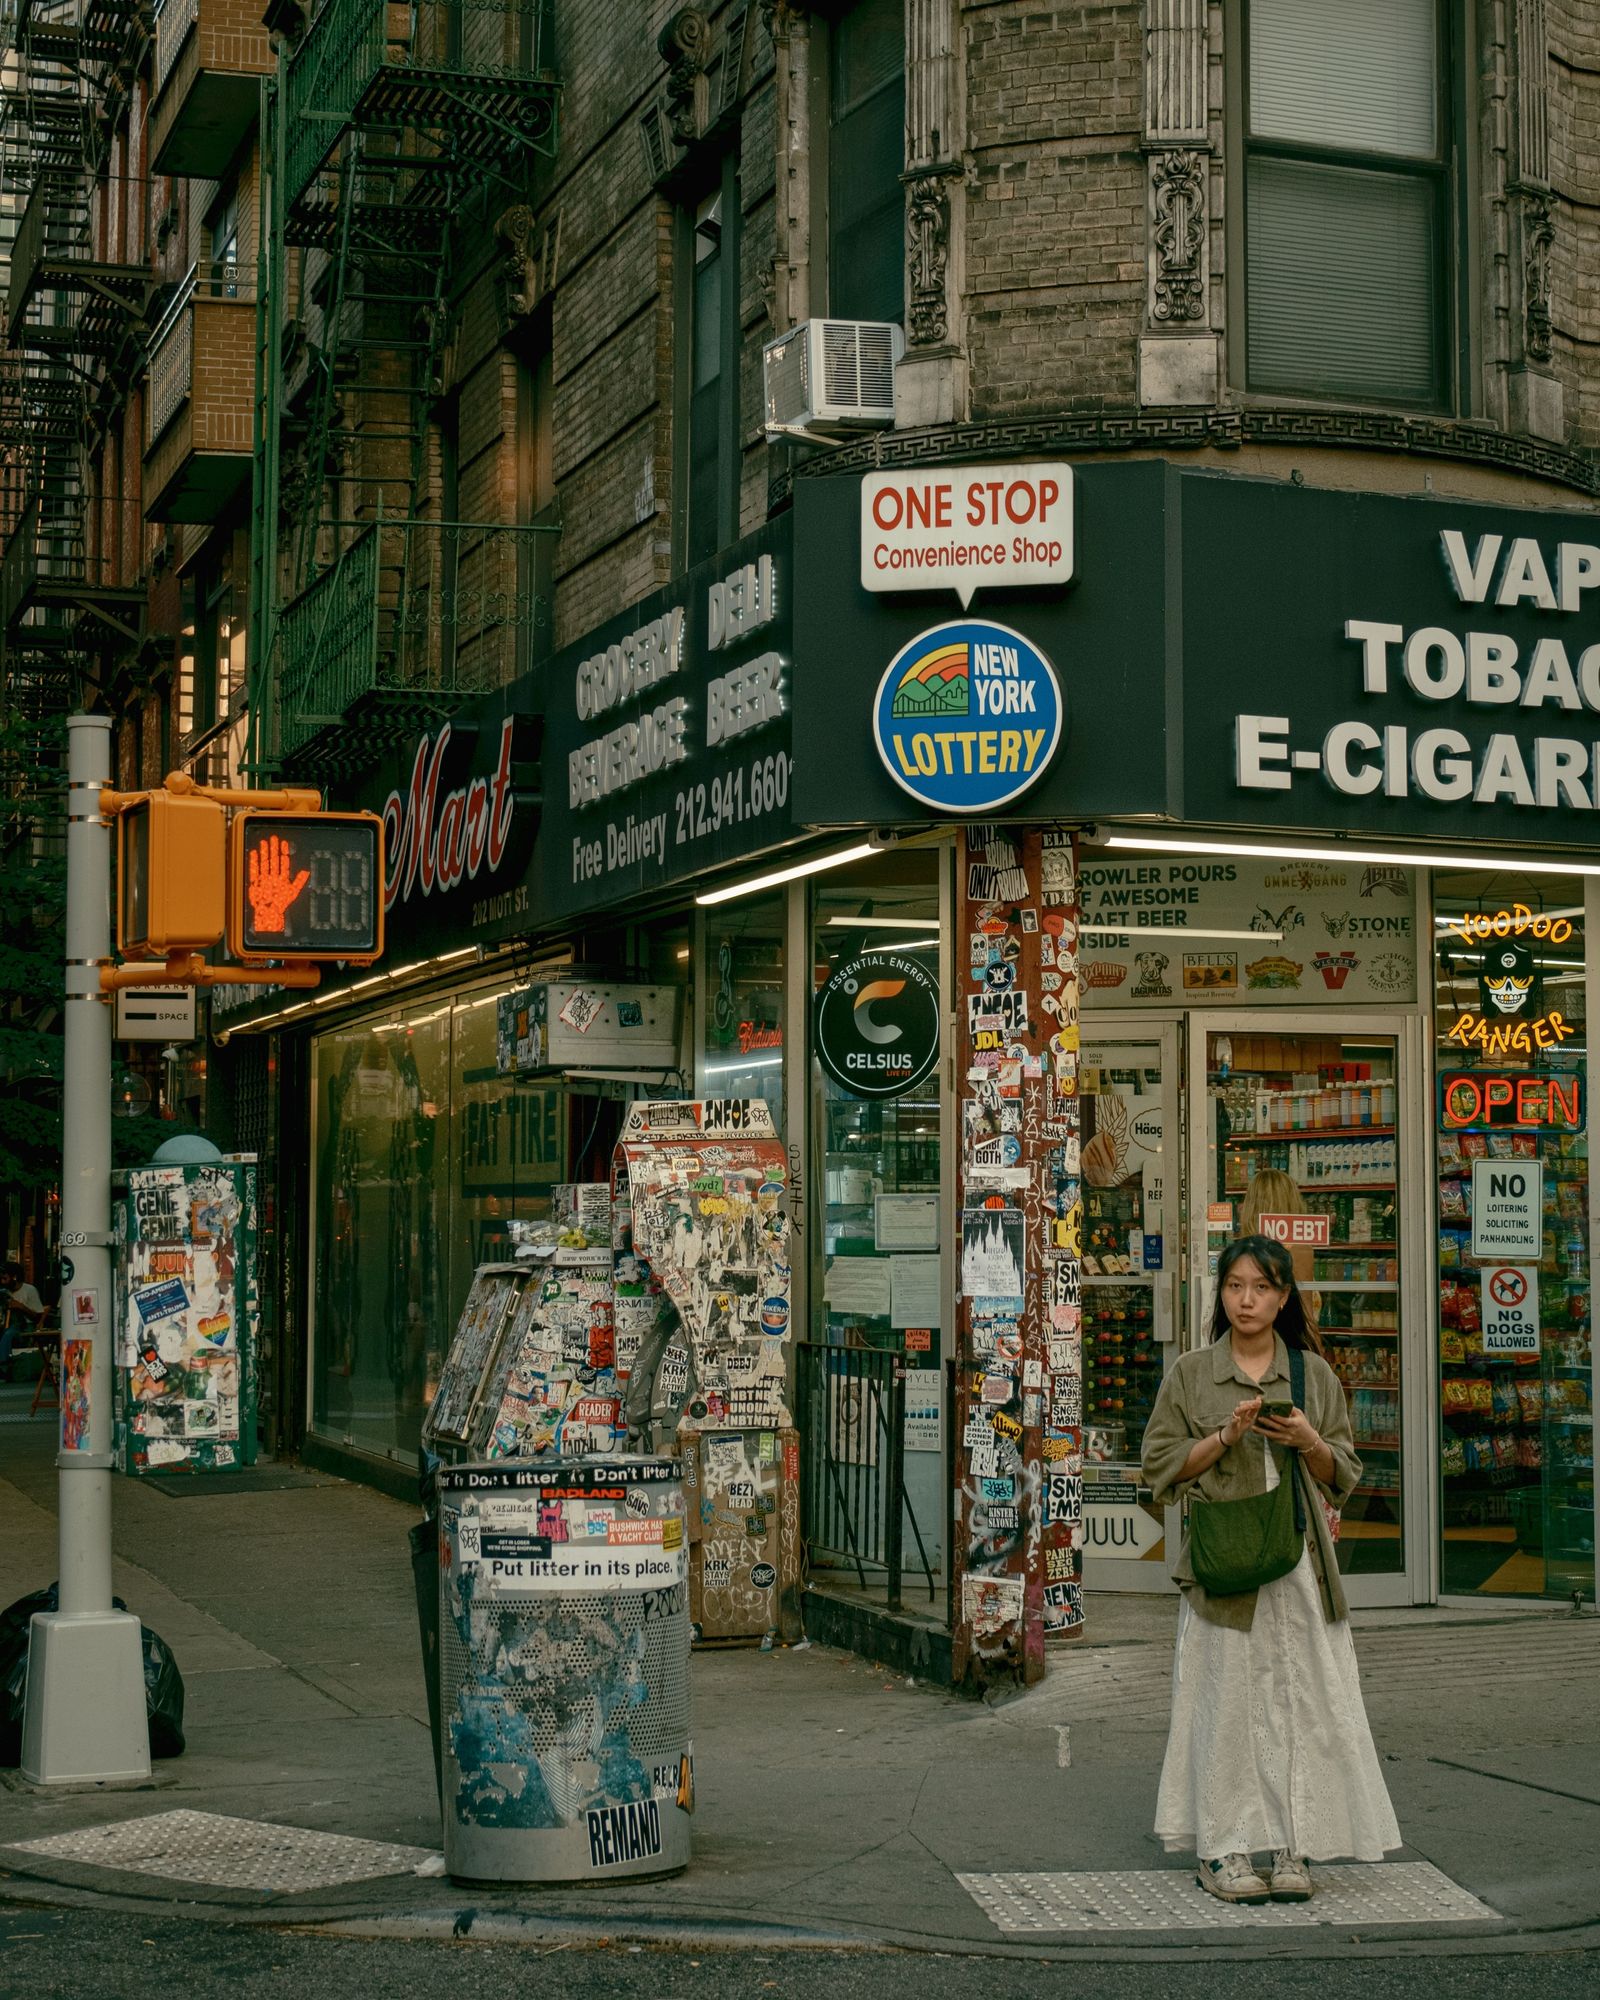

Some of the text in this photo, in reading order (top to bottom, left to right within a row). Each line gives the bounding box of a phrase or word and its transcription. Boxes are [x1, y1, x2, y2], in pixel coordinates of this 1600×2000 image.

[873, 480, 1059, 531] ONE STOP
[874, 537, 1062, 570] Convenience Shop
[576, 554, 773, 721] GROCERY DELI
[974, 643, 1018, 677] NEW
[974, 677, 1036, 715] YORK
[569, 652, 782, 809] BEVERAGE BEER
[892, 728, 1045, 777] LOTTERY
[1235, 714, 1600, 809] E-CIGAR
[573, 751, 793, 883] Free Delivery 212.941.660
[1043, 833, 1071, 846] ELK
[1280, 862, 1330, 873] BREWERY
[1080, 865, 1237, 886] ROWLER POURS
[1081, 887, 1199, 907] F AWESOME
[472, 885, 529, 927] 202 MOTT ST.
[1080, 910, 1187, 927] RAFT BEER
[1349, 917, 1410, 931] STONE
[1450, 903, 1573, 945] VOODOO
[1079, 933, 1129, 949] NSIDE
[1187, 955, 1234, 966] BELL'S
[1315, 958, 1356, 968] VICTORY
[1370, 953, 1412, 967] ANCHOR
[829, 955, 886, 991] ESSENTIAL
[1131, 986, 1172, 995] LAGUNITAS
[1449, 1011, 1575, 1055] RANGER
[846, 1053, 912, 1069] CELSIUS
[1445, 1078, 1579, 1125] OPEN
[975, 1151, 1001, 1164] GOTH
[694, 1179, 719, 1191] wyd?
[1490, 1174, 1526, 1198] NO
[1487, 1204, 1528, 1214] LOITERING
[1264, 1219, 1326, 1241] NO EBT
[1486, 1219, 1529, 1229] SOLICITING
[1480, 1234, 1534, 1245] PANHANDLING
[136, 1280, 180, 1301] PRO-AMERICA
[146, 1302, 186, 1322] ANTI-TRUMP
[1498, 1311, 1523, 1322] NO
[906, 1330, 929, 1340] FRIENDS
[1487, 1324, 1535, 1335] DOGS
[1487, 1336, 1536, 1348] ALLOWED
[663, 1364, 688, 1375] KRK
[662, 1375, 686, 1385] STAYS
[661, 1384, 685, 1392] ACTIVE
[580, 1402, 612, 1416] READER
[594, 1467, 637, 1482] Don't
[542, 1488, 625, 1499] BADLAND
[729, 1499, 753, 1509] HEAD
[609, 1521, 649, 1532] BUSHWICK
[651, 1520, 663, 1530] HAS
[1082, 1517, 1138, 1546] JUUL
[609, 1534, 615, 1542] A
[617, 1532, 642, 1542] YACHT
[1045, 1548, 1073, 1560] PANIC
[492, 1558, 672, 1578] Put litter in its place.
[705, 1560, 729, 1570] KRK
[705, 1571, 730, 1580] STAYS
[587, 1801, 661, 1866] REMAND
